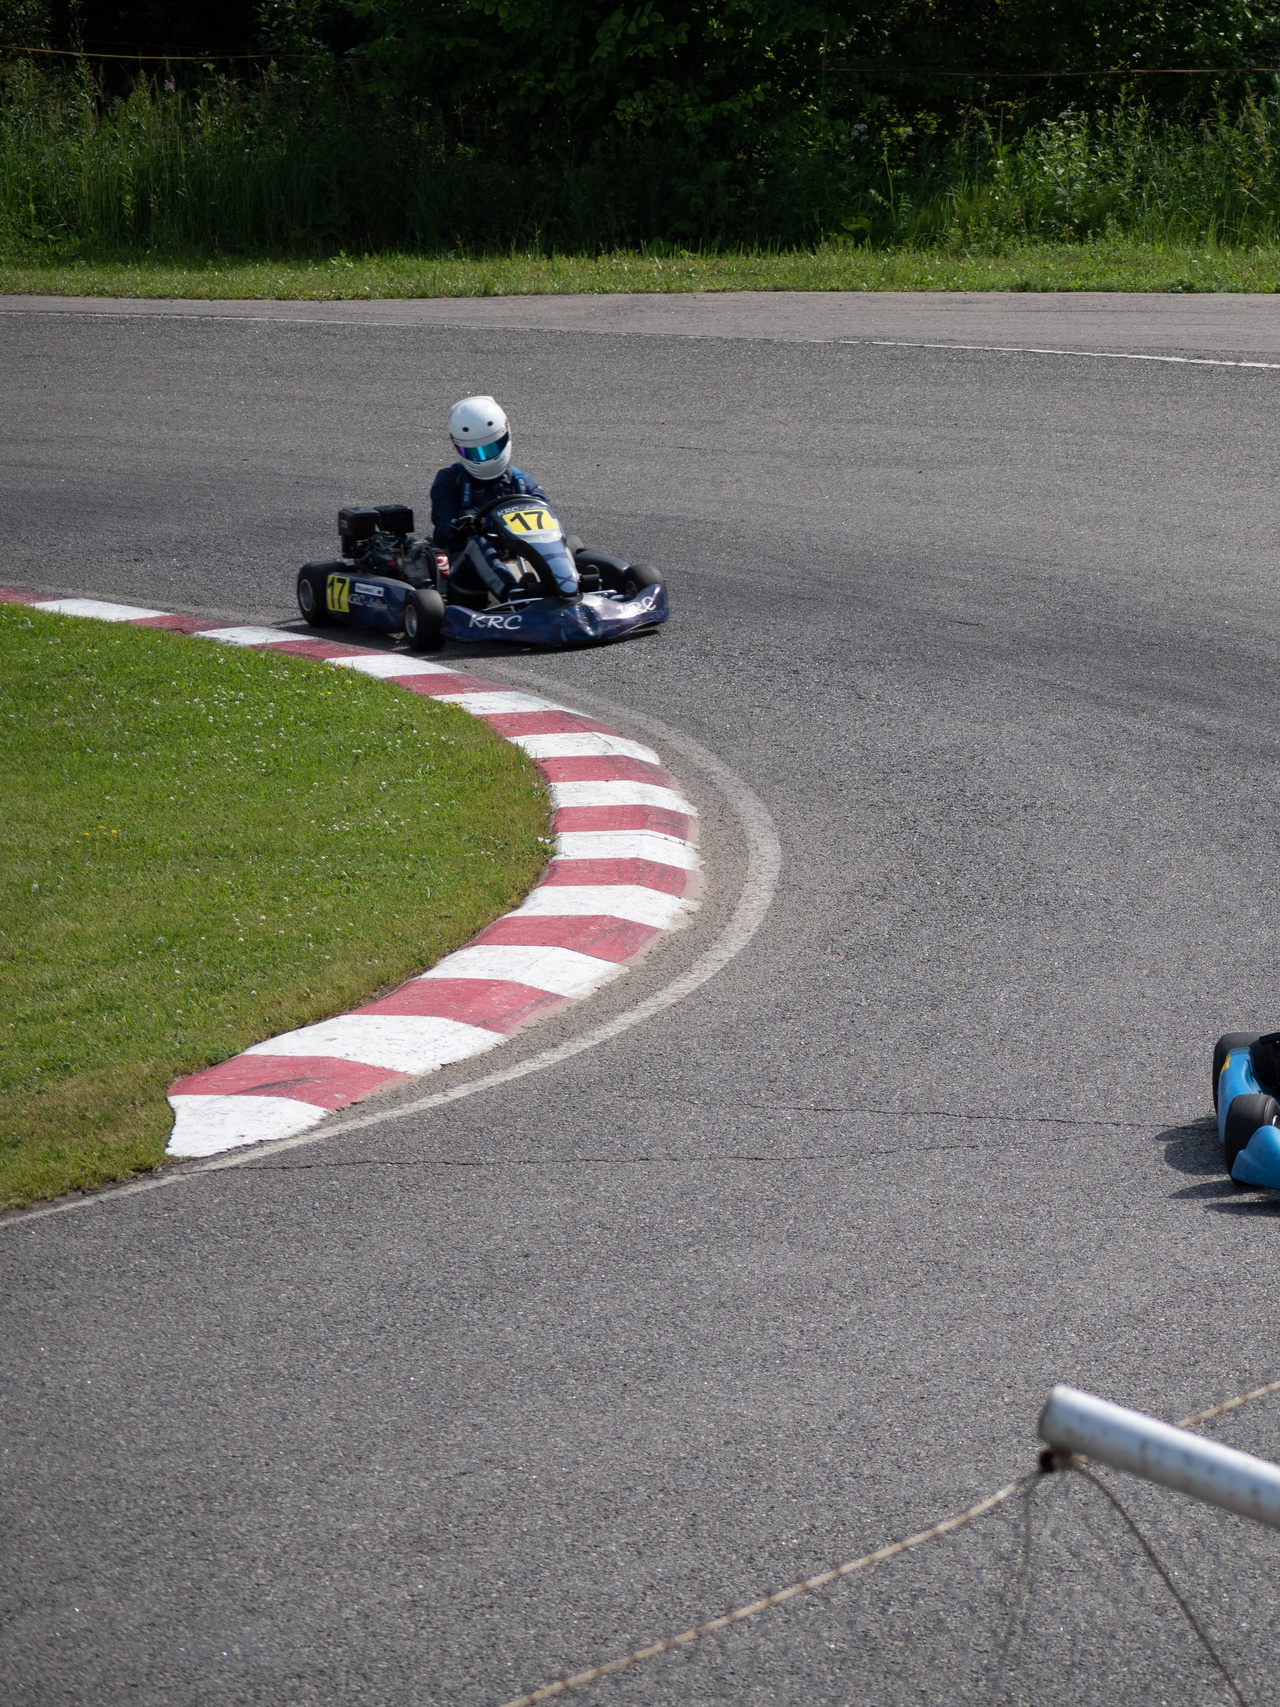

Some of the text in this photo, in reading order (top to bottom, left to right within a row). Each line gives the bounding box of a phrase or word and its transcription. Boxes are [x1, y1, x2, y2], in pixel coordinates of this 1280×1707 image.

[510, 511, 543, 531] 17
[327, 576, 347, 610] 17
[468, 613, 523, 630] KRC
